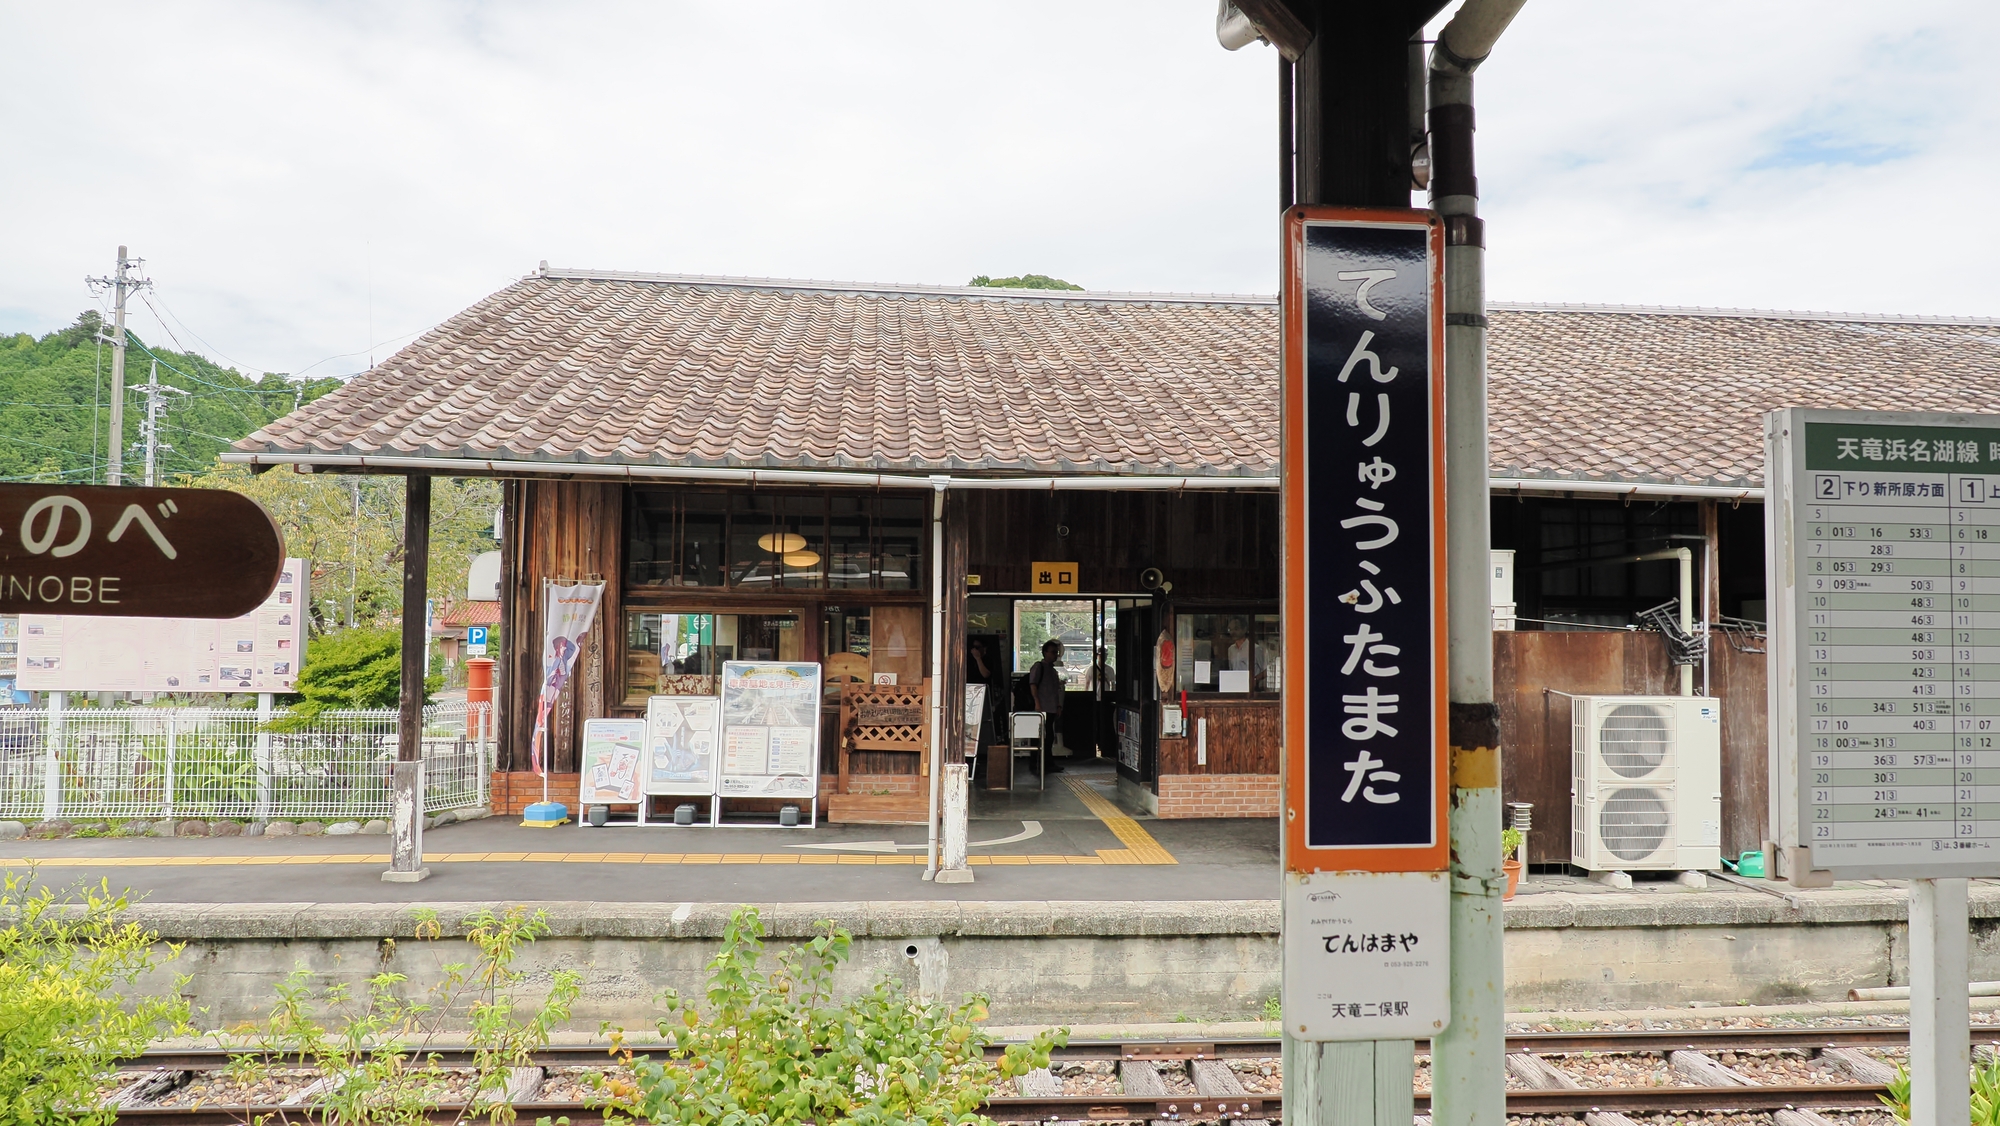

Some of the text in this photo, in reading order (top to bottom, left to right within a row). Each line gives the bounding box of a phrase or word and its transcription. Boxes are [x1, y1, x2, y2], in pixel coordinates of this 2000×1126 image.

[1837, 438, 1980, 463] 天竜浜名湖線
[1815, 509, 1822, 519] 5
[1958, 512, 1964, 522] 5
[0, 495, 179, 560] のべ
[1815, 527, 1822, 537] 6
[1337, 269, 1400, 803] てんりゅうふたまた
[1958, 529, 1965, 539] 6
[1815, 544, 1823, 554] 7
[1958, 547, 1965, 556] 7
[1816, 562, 1823, 572] 8
[1959, 564, 1966, 574] 8
[1038, 571, 1072, 584] 出口
[1816, 579, 1823, 589] 9
[1959, 581, 1966, 591] 9
[1814, 597, 1827, 607] 10
[1957, 598, 1970, 608] 10
[1814, 615, 1825, 625] 11
[1958, 616, 1969, 626] 11
[472, 628, 484, 643] P
[1814, 632, 1827, 642] 12
[1958, 633, 1970, 643] 12
[1815, 650, 1827, 660] 13
[1958, 650, 1970, 661] 13
[1815, 668, 1828, 677] 14
[1959, 668, 1971, 678] 14
[1815, 685, 1828, 695] 15
[1959, 685, 1971, 696] 15
[1816, 703, 1828, 713] 16
[1959, 703, 1972, 713] 16
[1816, 720, 1828, 730] 17
[1959, 720, 1972, 730] 17
[1816, 738, 1829, 748] 18
[1960, 738, 1972, 748] 18
[1816, 756, 1829, 766] 19
[1960, 755, 1972, 765] 19
[1816, 773, 1829, 784] 20
[1959, 772, 1973, 783] 20
[1816, 791, 1828, 802] 21
[1960, 790, 1971, 800] 21
[1816, 809, 1829, 819] 22
[1960, 807, 1973, 818] 22
[1816, 827, 1830, 837] 23
[1960, 825, 1973, 835] 23
[1322, 932, 1418, 953] てんはまや
[1332, 1001, 1409, 1018] 天竜二俣駅
